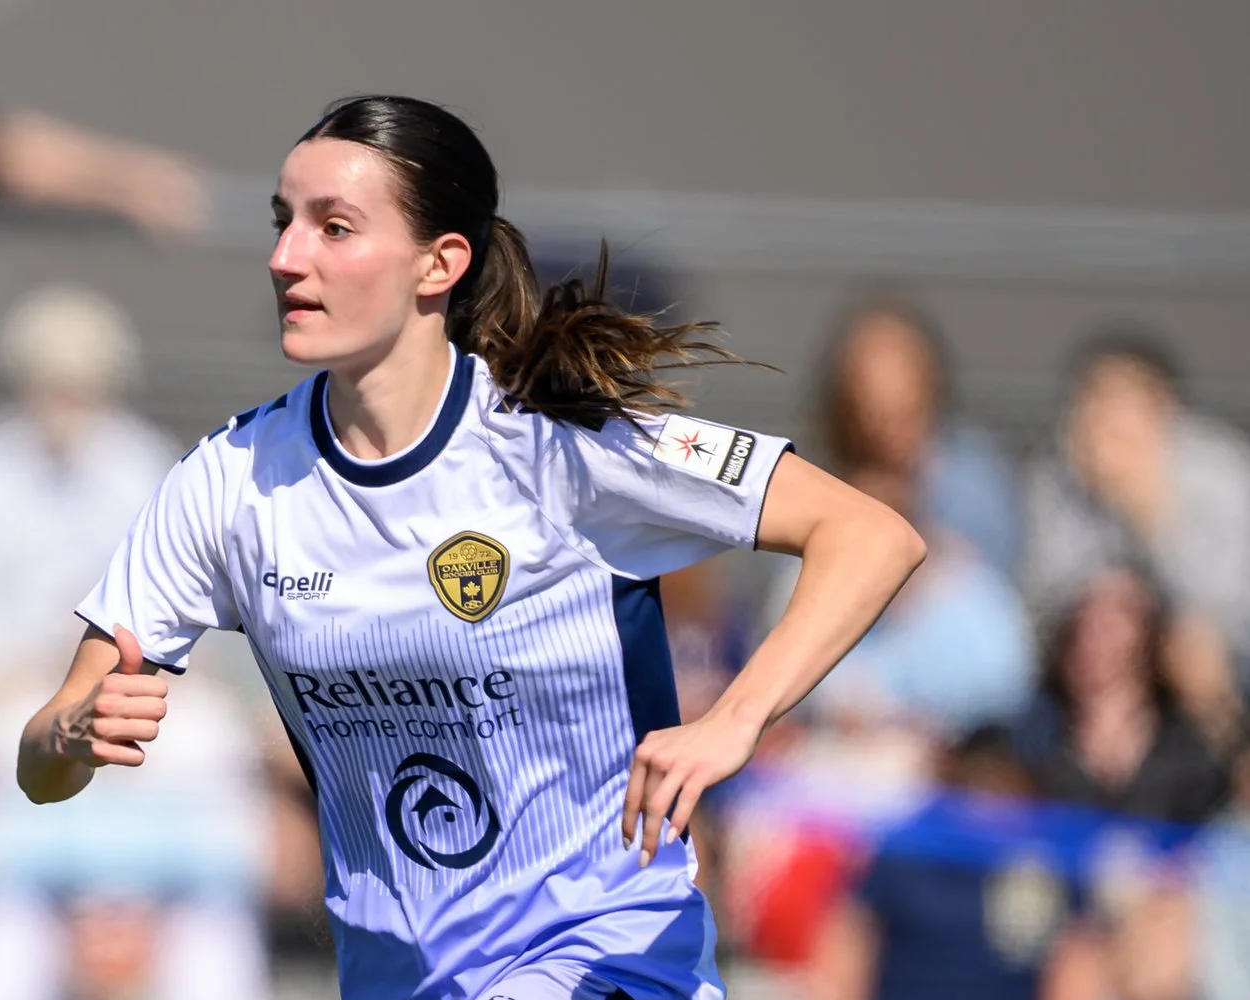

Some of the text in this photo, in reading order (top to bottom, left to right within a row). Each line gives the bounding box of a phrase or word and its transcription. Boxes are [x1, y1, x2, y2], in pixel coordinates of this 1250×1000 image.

[733, 435, 753, 458] ON
[442, 560, 498, 573] OAKVILLE
[263, 571, 333, 597] cpelli
[286, 592, 329, 601] SPORT
[284, 669, 516, 713] Reliance
[307, 705, 524, 743] home comfort
